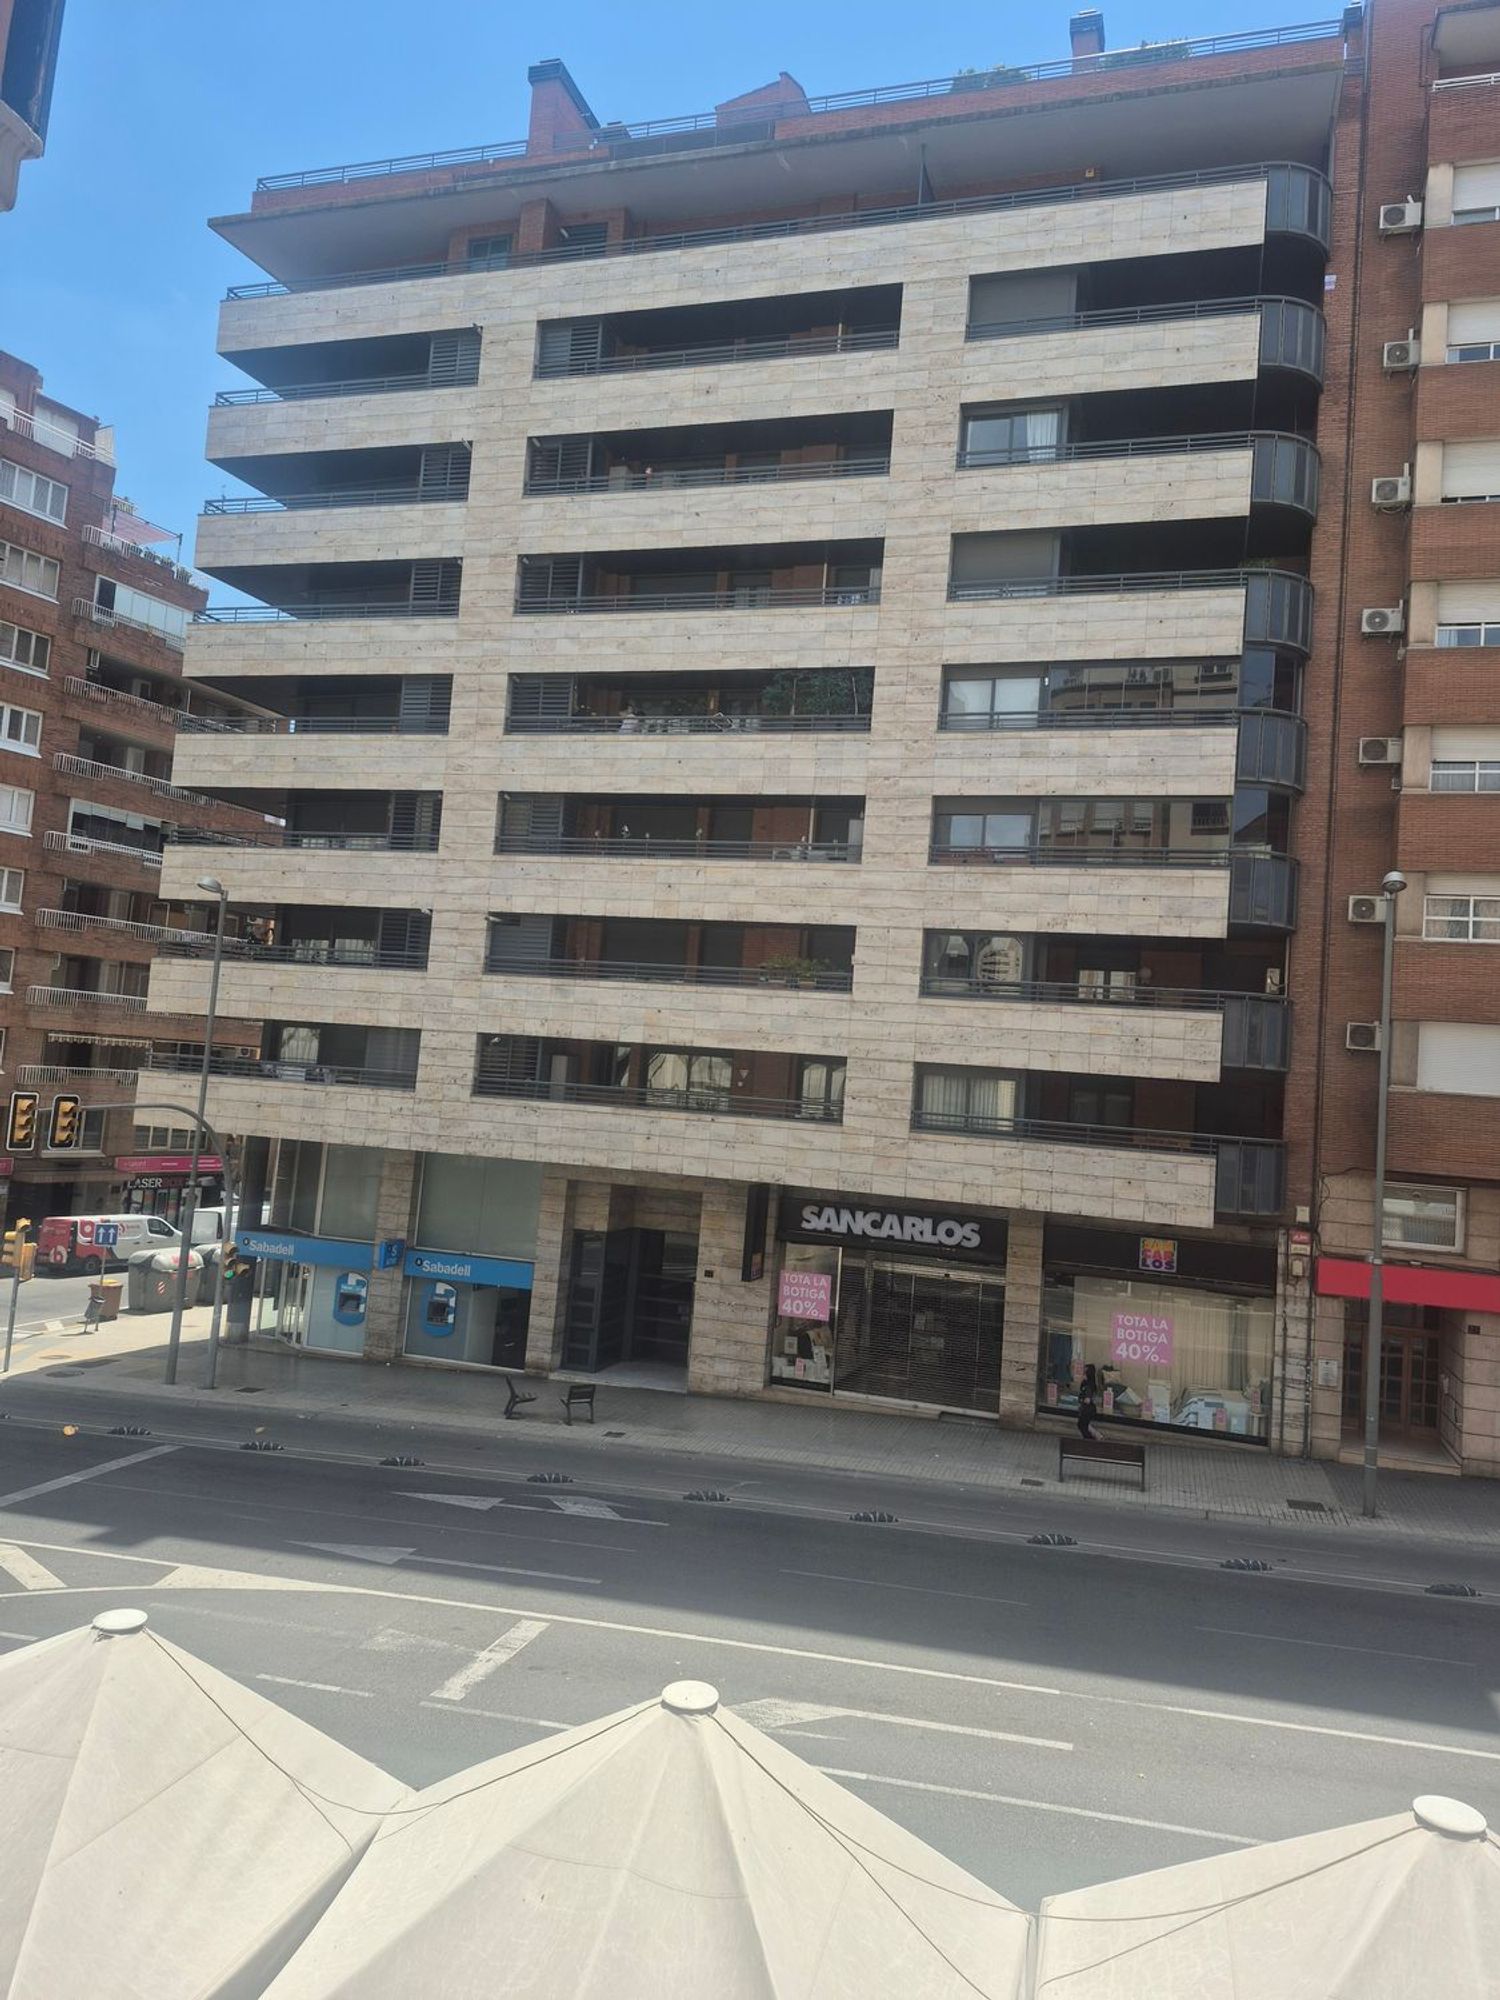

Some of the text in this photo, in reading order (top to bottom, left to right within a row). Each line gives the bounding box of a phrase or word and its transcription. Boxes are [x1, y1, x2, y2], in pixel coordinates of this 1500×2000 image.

[127, 1177, 163, 1190] LASER
[801, 1205, 981, 1248] SANCARLOS
[249, 1241, 295, 1256] Sabadell
[422, 1260, 471, 1277] Sabadell
[1142, 1258, 1175, 1270] LOS
[785, 1273, 827, 1287] TOTA LA
[783, 1285, 827, 1300] BOTIGA
[782, 1298, 819, 1316] 40%
[1117, 1314, 1169, 1331] TOTA LA
[1117, 1327, 1168, 1345] BOTIGA
[1115, 1342, 1160, 1362] 40%
